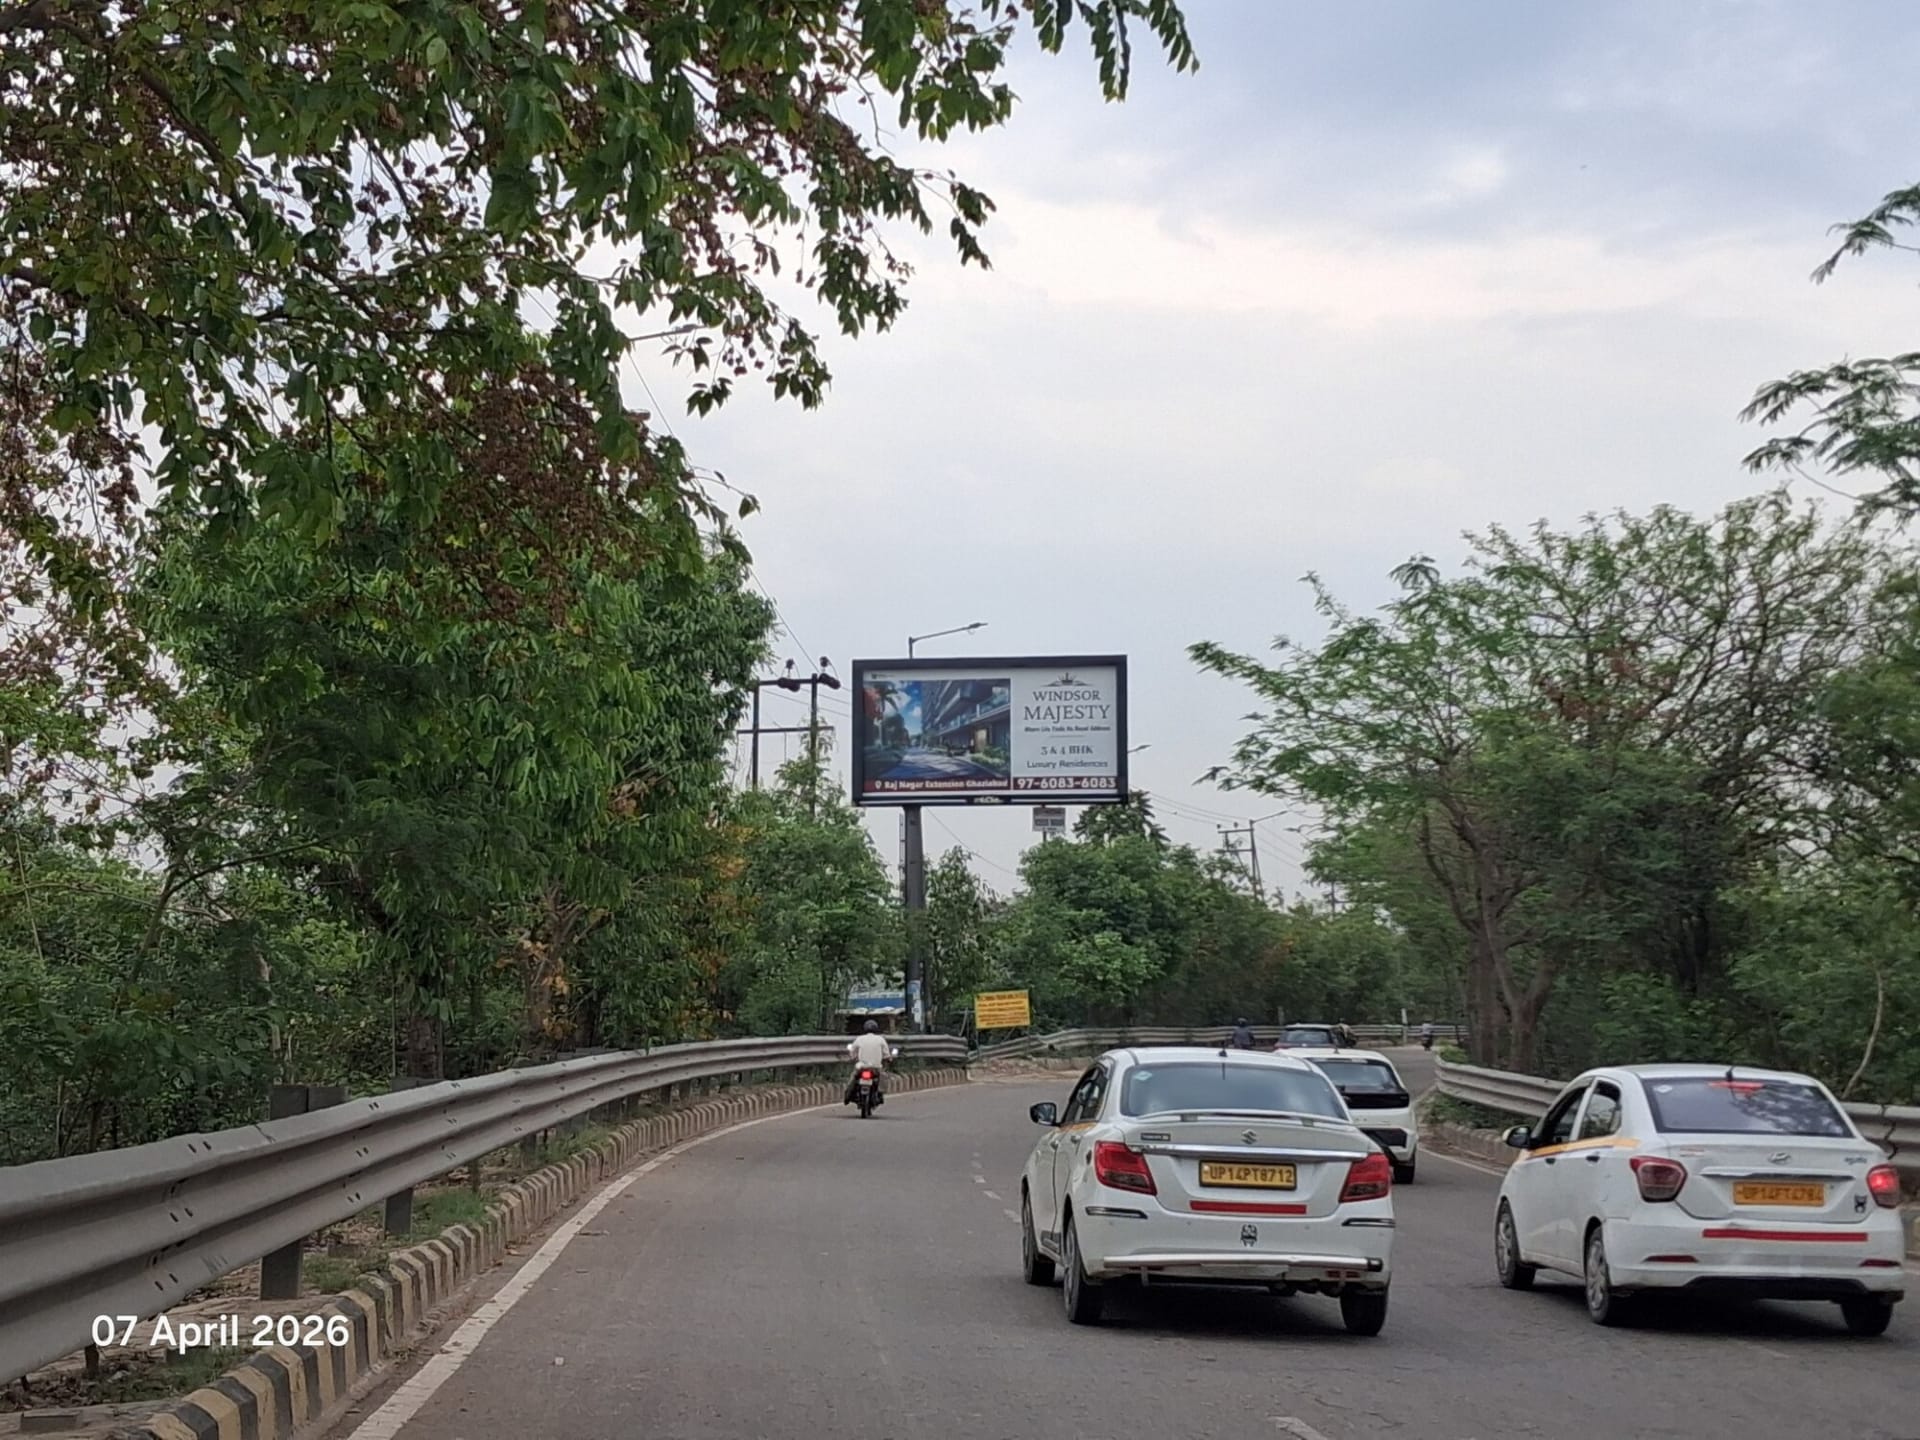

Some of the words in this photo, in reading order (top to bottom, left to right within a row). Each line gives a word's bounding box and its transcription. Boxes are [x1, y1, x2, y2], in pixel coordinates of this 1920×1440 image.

[1033, 690, 1101, 702] WINDSOR
[1023, 705, 1110, 723] MAJESTY
[1068, 745, 1094, 755] BHK
[1027, 761, 1057, 769] Luxury
[1059, 759, 1108, 768] Residences
[884, 780, 898, 790] Raj
[899, 780, 924, 790] Nagar
[925, 780, 965, 788] Extension
[966, 779, 1008, 787] Ghaziabad
[1017, 777, 1116, 789] 97-6083-6083
